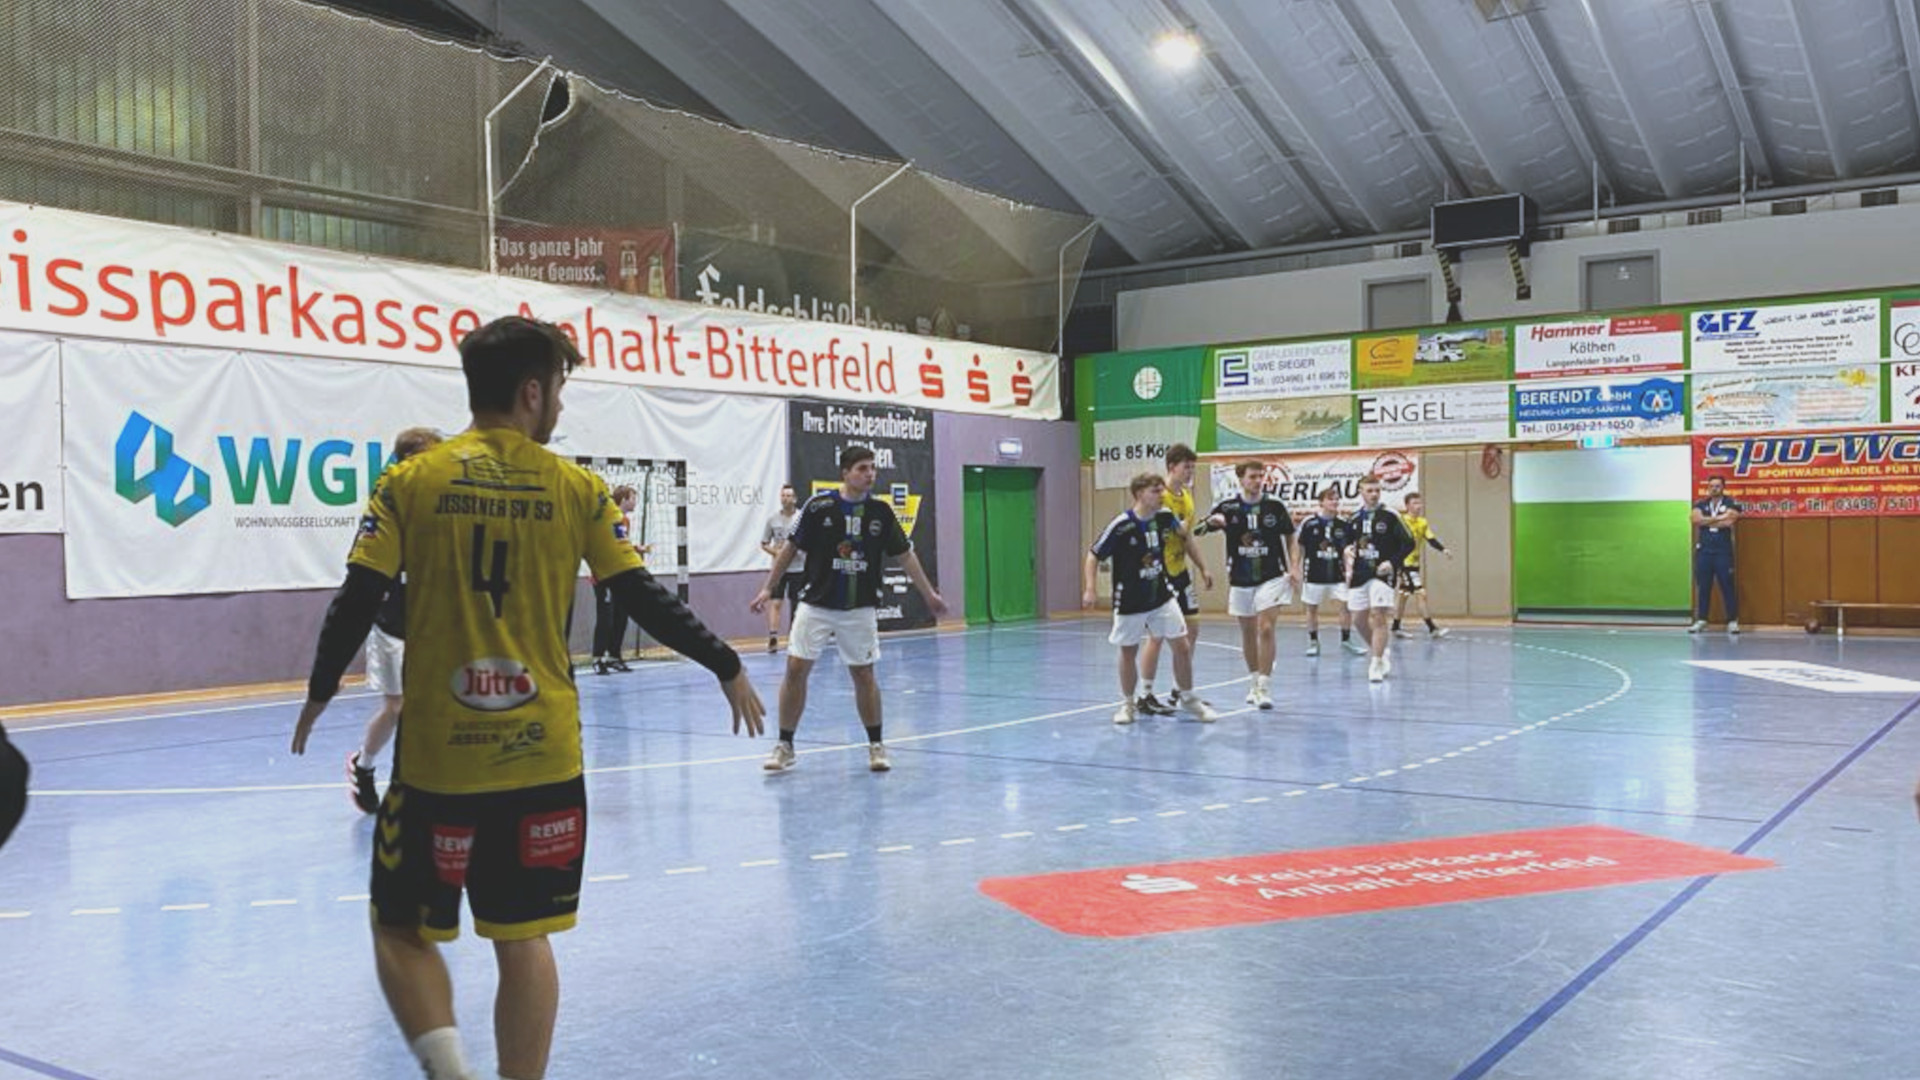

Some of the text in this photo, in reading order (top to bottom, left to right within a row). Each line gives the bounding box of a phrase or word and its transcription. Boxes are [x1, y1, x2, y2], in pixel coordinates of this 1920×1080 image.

[500, 237, 603, 260] Das ganze Jahr
[548, 262, 601, 283] Genuss.
[0, 229, 484, 354] issparkasse
[1530, 324, 1606, 343] Hammer
[1569, 342, 1616, 355] Köthen
[1252, 358, 1315, 373] UWE SIEGER
[1520, 389, 1593, 405] BERENDT
[1359, 397, 1455, 424] ENGEL
[803, 406, 926, 440] Ihre Frischeanbieter
[1099, 443, 1170, 463] HG 85 Kö
[1758, 465, 1881, 479] SPORTWARENHANDEL
[688, 484, 720, 505] DER
[435, 494, 506, 518] JESSENER
[510, 499, 530, 520] SV
[234, 516, 356, 529] WOHNUNGSGESELLSCHAFT
[472, 523, 511, 619] 4
[530, 816, 577, 839] REWE
[1215, 849, 1541, 887] Kreissparkasse
[1257, 862, 1619, 900] Anhalt-Bitterfeld
